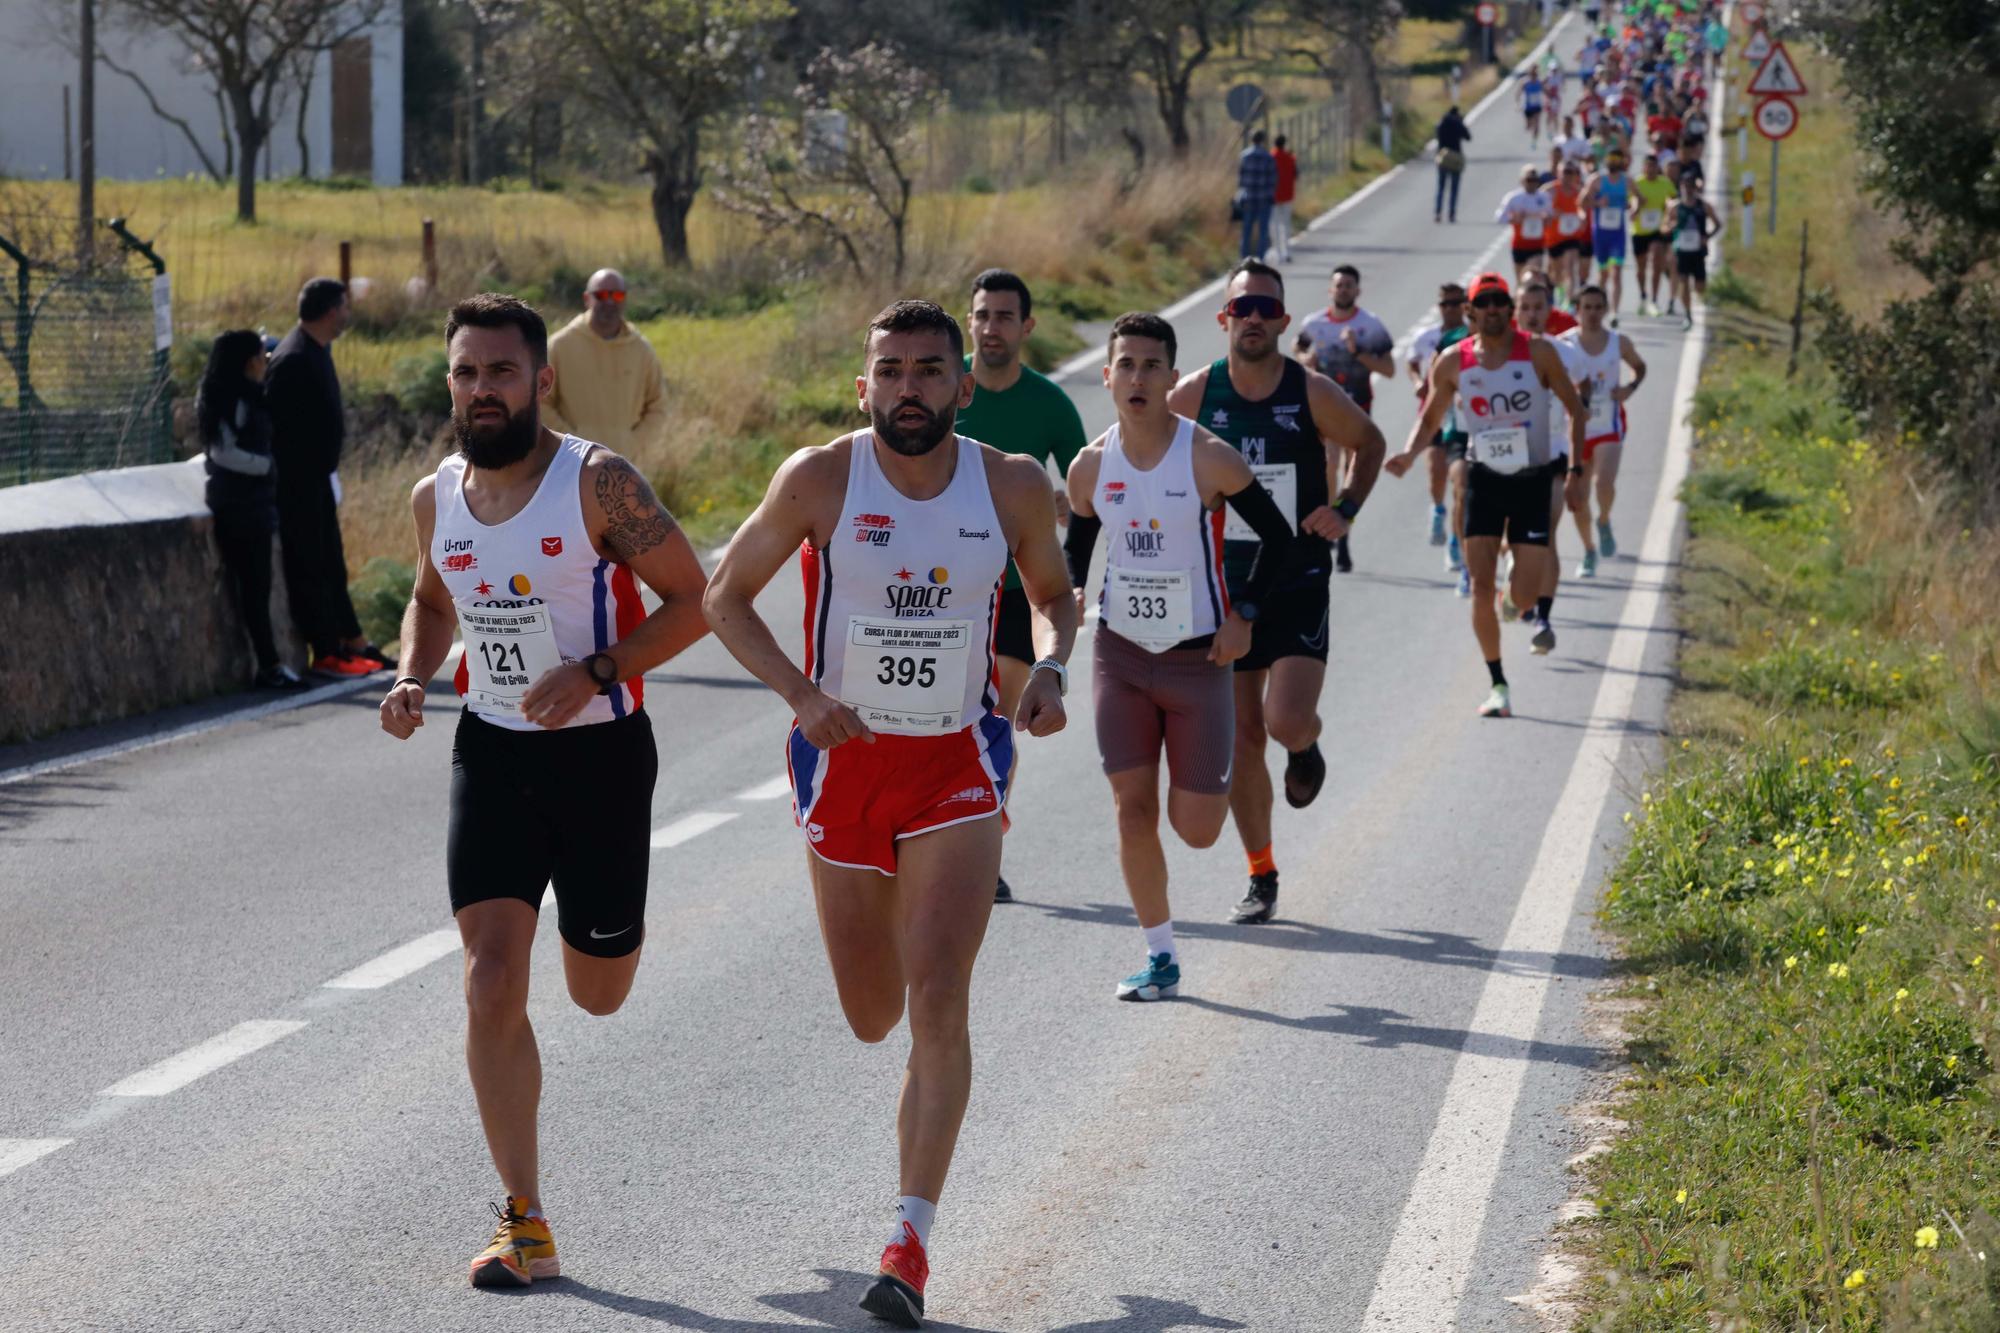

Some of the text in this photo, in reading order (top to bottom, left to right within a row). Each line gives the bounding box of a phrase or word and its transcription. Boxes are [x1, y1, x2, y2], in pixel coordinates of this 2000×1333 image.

[1489, 444, 1513, 458] 354
[444, 539, 474, 552] U-run
[902, 609, 935, 617] IBIZA
[1128, 595, 1167, 619] 333
[518, 615, 536, 625] 2023
[864, 627, 959, 639] CURSA FLOR D'AMETLLER 2023
[480, 641, 526, 671] 121
[877, 655, 937, 688] 395
